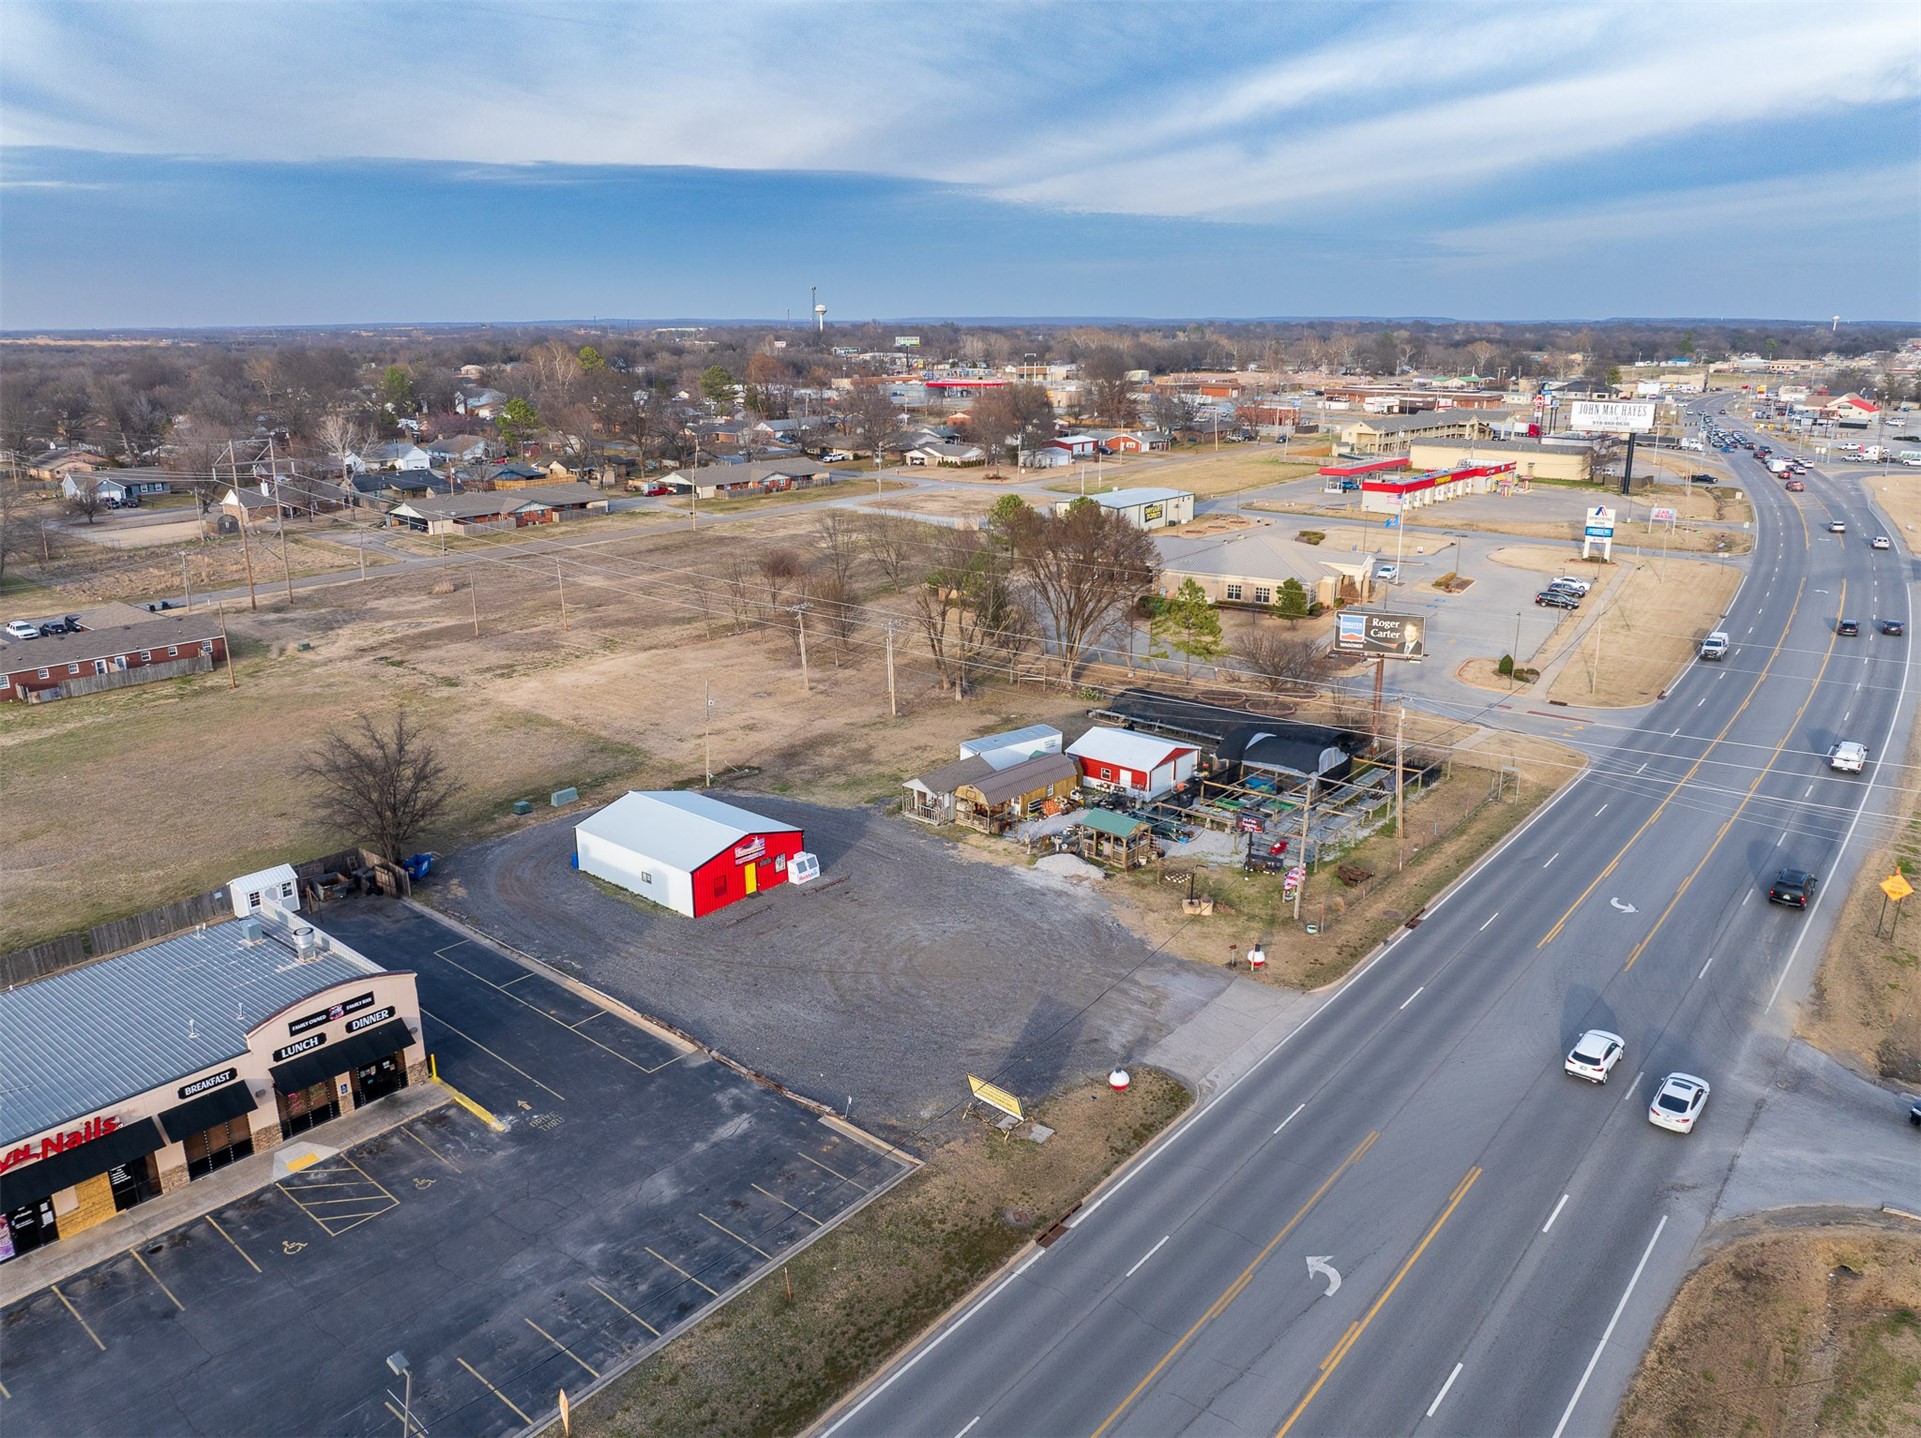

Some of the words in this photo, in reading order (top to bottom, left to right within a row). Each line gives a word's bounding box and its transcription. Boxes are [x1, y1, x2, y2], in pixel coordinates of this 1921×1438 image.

[1579, 403, 1600, 415] JOHN
[1602, 404, 1618, 416] MAC
[1621, 405, 1648, 417] HAYES
[1372, 618, 1400, 629] Roger
[1370, 628, 1400, 639] Carter
[352, 1009, 389, 1030] DINNER
[281, 1036, 319, 1058] LUNCH
[184, 1071, 230, 1096] BREAKFAST
[529, 1110, 559, 1127] DRIVE
[538, 1116, 565, 1132] THRU
[41, 1116, 116, 1159] Nails
